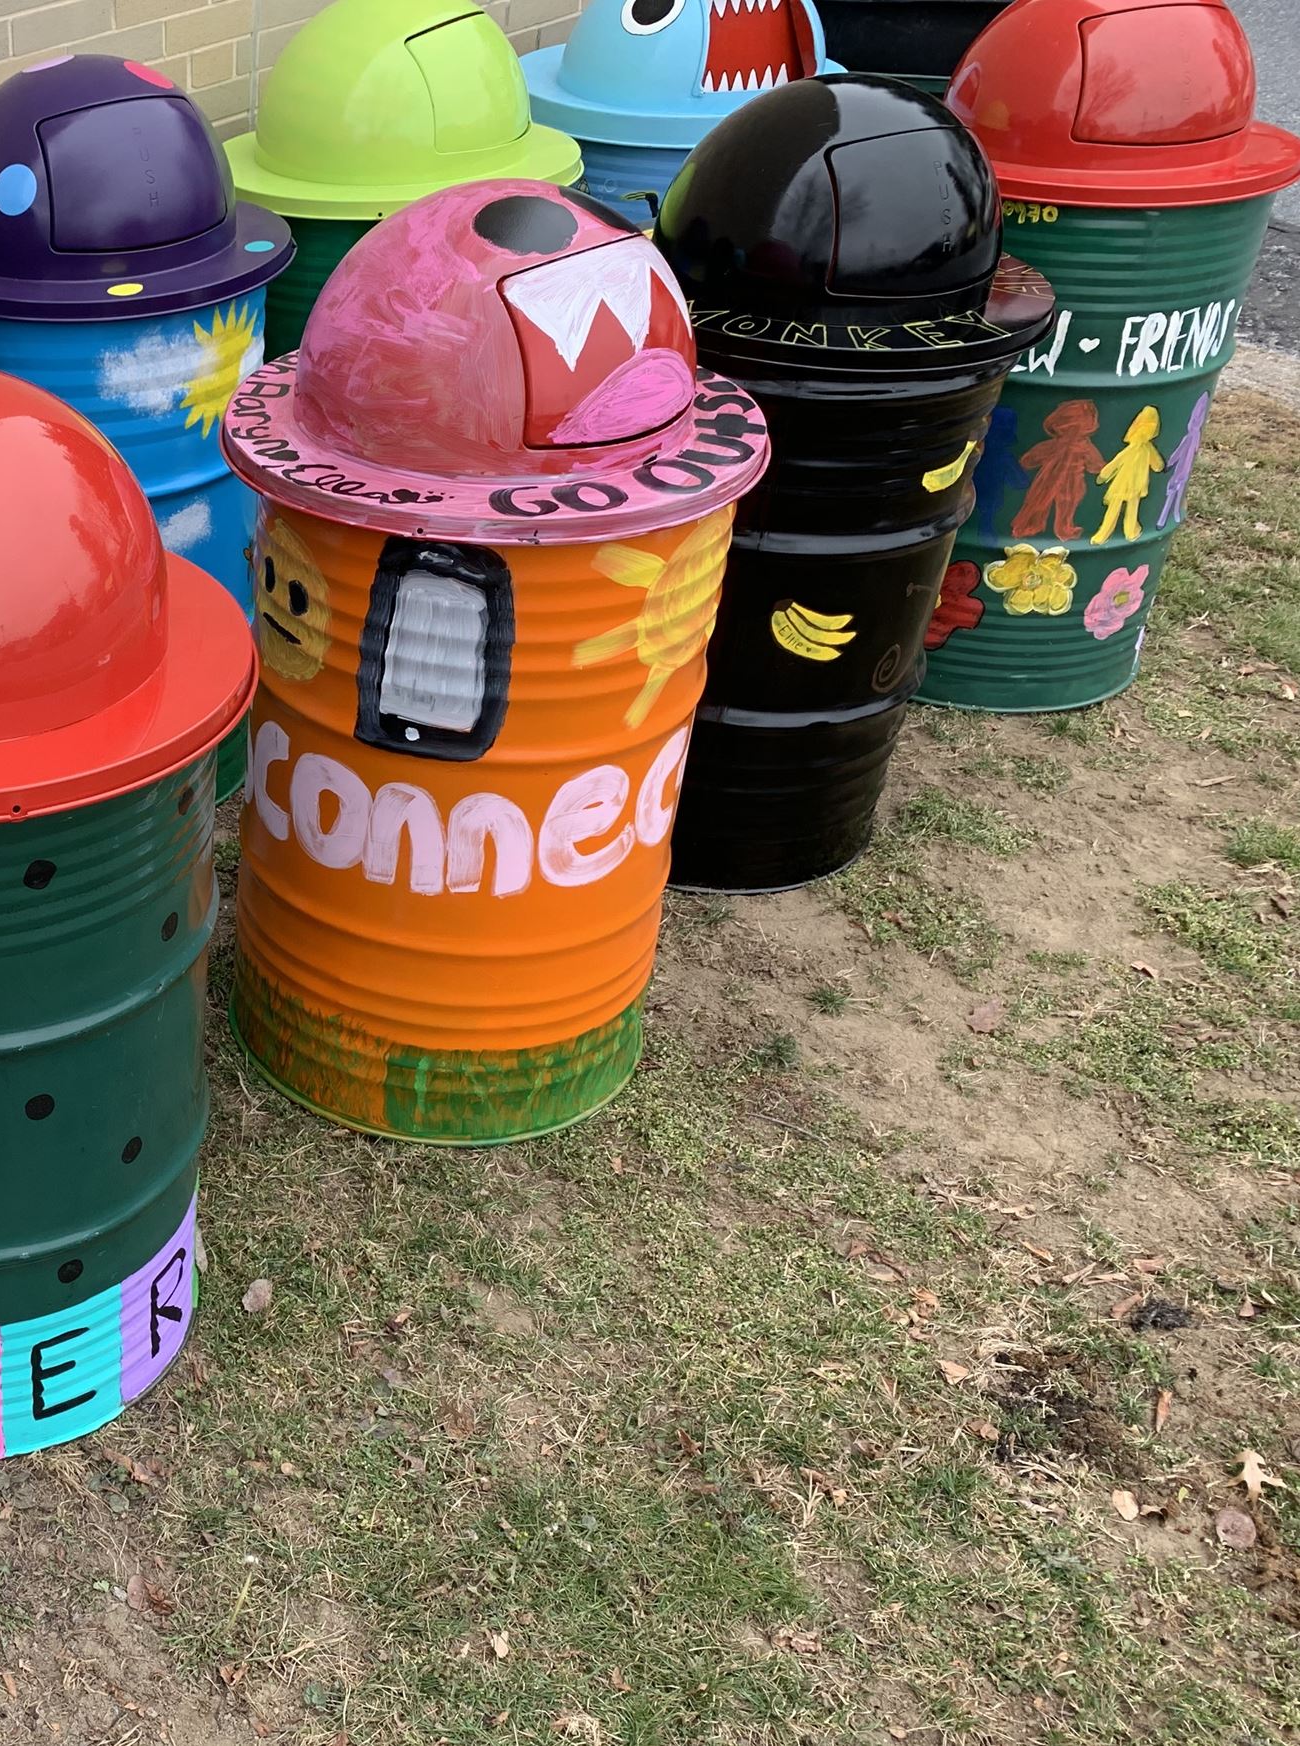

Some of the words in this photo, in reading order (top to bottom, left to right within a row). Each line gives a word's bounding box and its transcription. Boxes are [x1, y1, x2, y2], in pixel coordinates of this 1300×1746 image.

[132, 126, 159, 208] PUSH
[933, 160, 952, 252] PUSH
[488, 481, 628, 515] GO
[246, 715, 690, 896] connec
